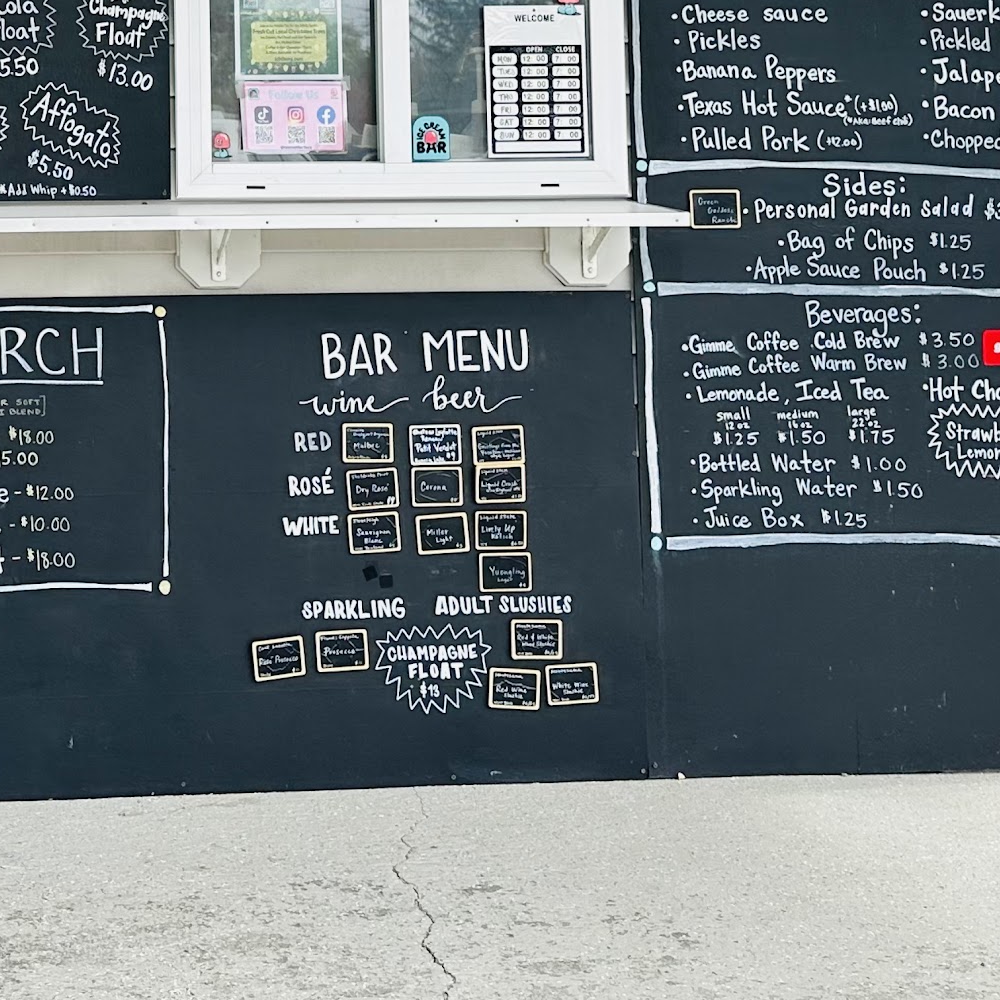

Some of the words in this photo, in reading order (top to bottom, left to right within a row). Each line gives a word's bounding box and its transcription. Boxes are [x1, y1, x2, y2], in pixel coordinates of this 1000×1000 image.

[682, 4, 749, 24] Cheese
[764, 8, 828, 22] sauce
[688, 28, 760, 53] Pickles
[29, 91, 112, 159] Affogato
[417, 141, 446, 153] BAR
[28, 150, 73, 180] $5.50
[822, 172, 906, 198] Sides:
[754, 198, 835, 223] Personal
[845, 197, 910, 218] Garden
[921, 194, 973, 217] Salad
[805, 300, 921, 340] Beverages:
[322, 333, 397, 379] BAR
[423, 329, 528, 372] MENU
[299, 391, 409, 415] wine
[422, 375, 522, 412] beer
[696, 382, 789, 405] Lemonade,
[795, 379, 842, 401] Iced
[850, 377, 889, 400] Tea
[9, 426, 54, 445] $18.00
[295, 431, 331, 452] RED
[26, 484, 74, 500] $12.00
[288, 467, 334, 496] ROSÉ
[421, 481, 447, 492] Corona
[283, 515, 339, 535] WHITE
[704, 506, 751, 528] Juice
[761, 507, 804, 528] Box
[821, 509, 866, 528] $1.25
[27, 548, 75, 571] $18.00
[302, 597, 405, 619] SPARKLING
[435, 595, 493, 615] ADULT
[499, 596, 571, 614] SLUSHIES
[387, 643, 477, 662] CHAMPAGNE
[408, 662, 464, 680] FLOAT
[420, 681, 440, 698] $13
